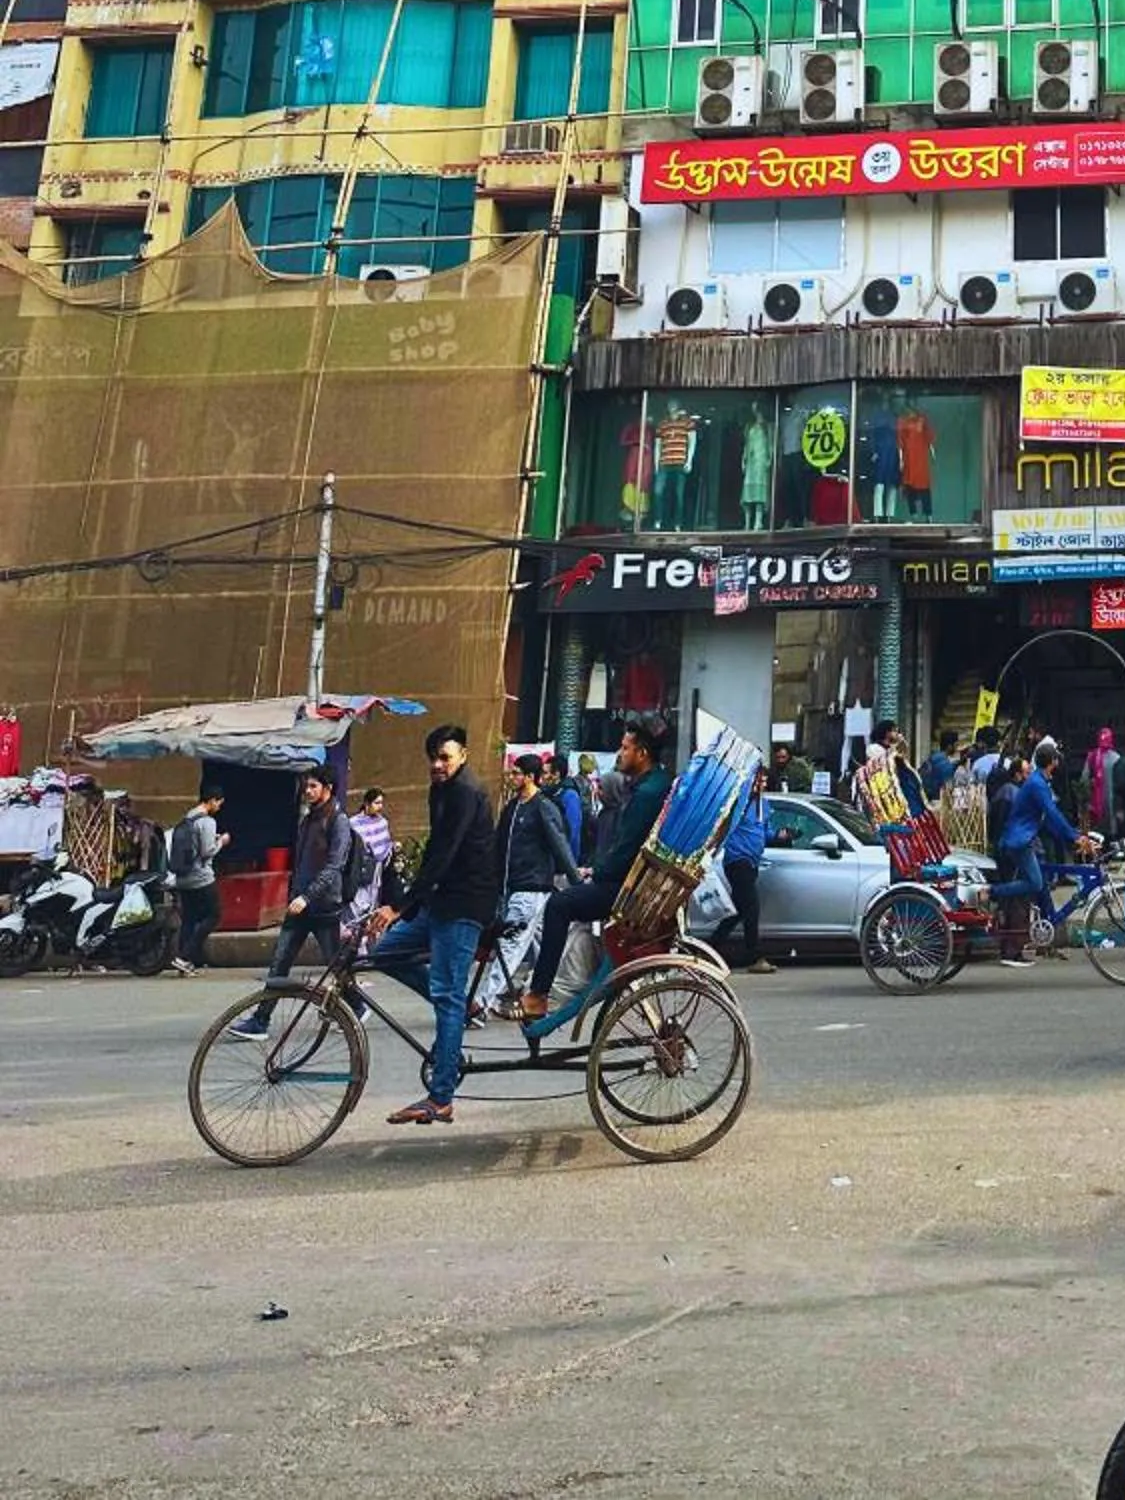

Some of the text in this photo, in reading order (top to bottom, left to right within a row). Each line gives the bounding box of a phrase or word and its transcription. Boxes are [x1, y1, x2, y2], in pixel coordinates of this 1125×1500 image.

[908, 139, 1027, 180] উত্তরণ
[612, 551, 852, 589] Freone
[903, 558, 992, 583] milan
